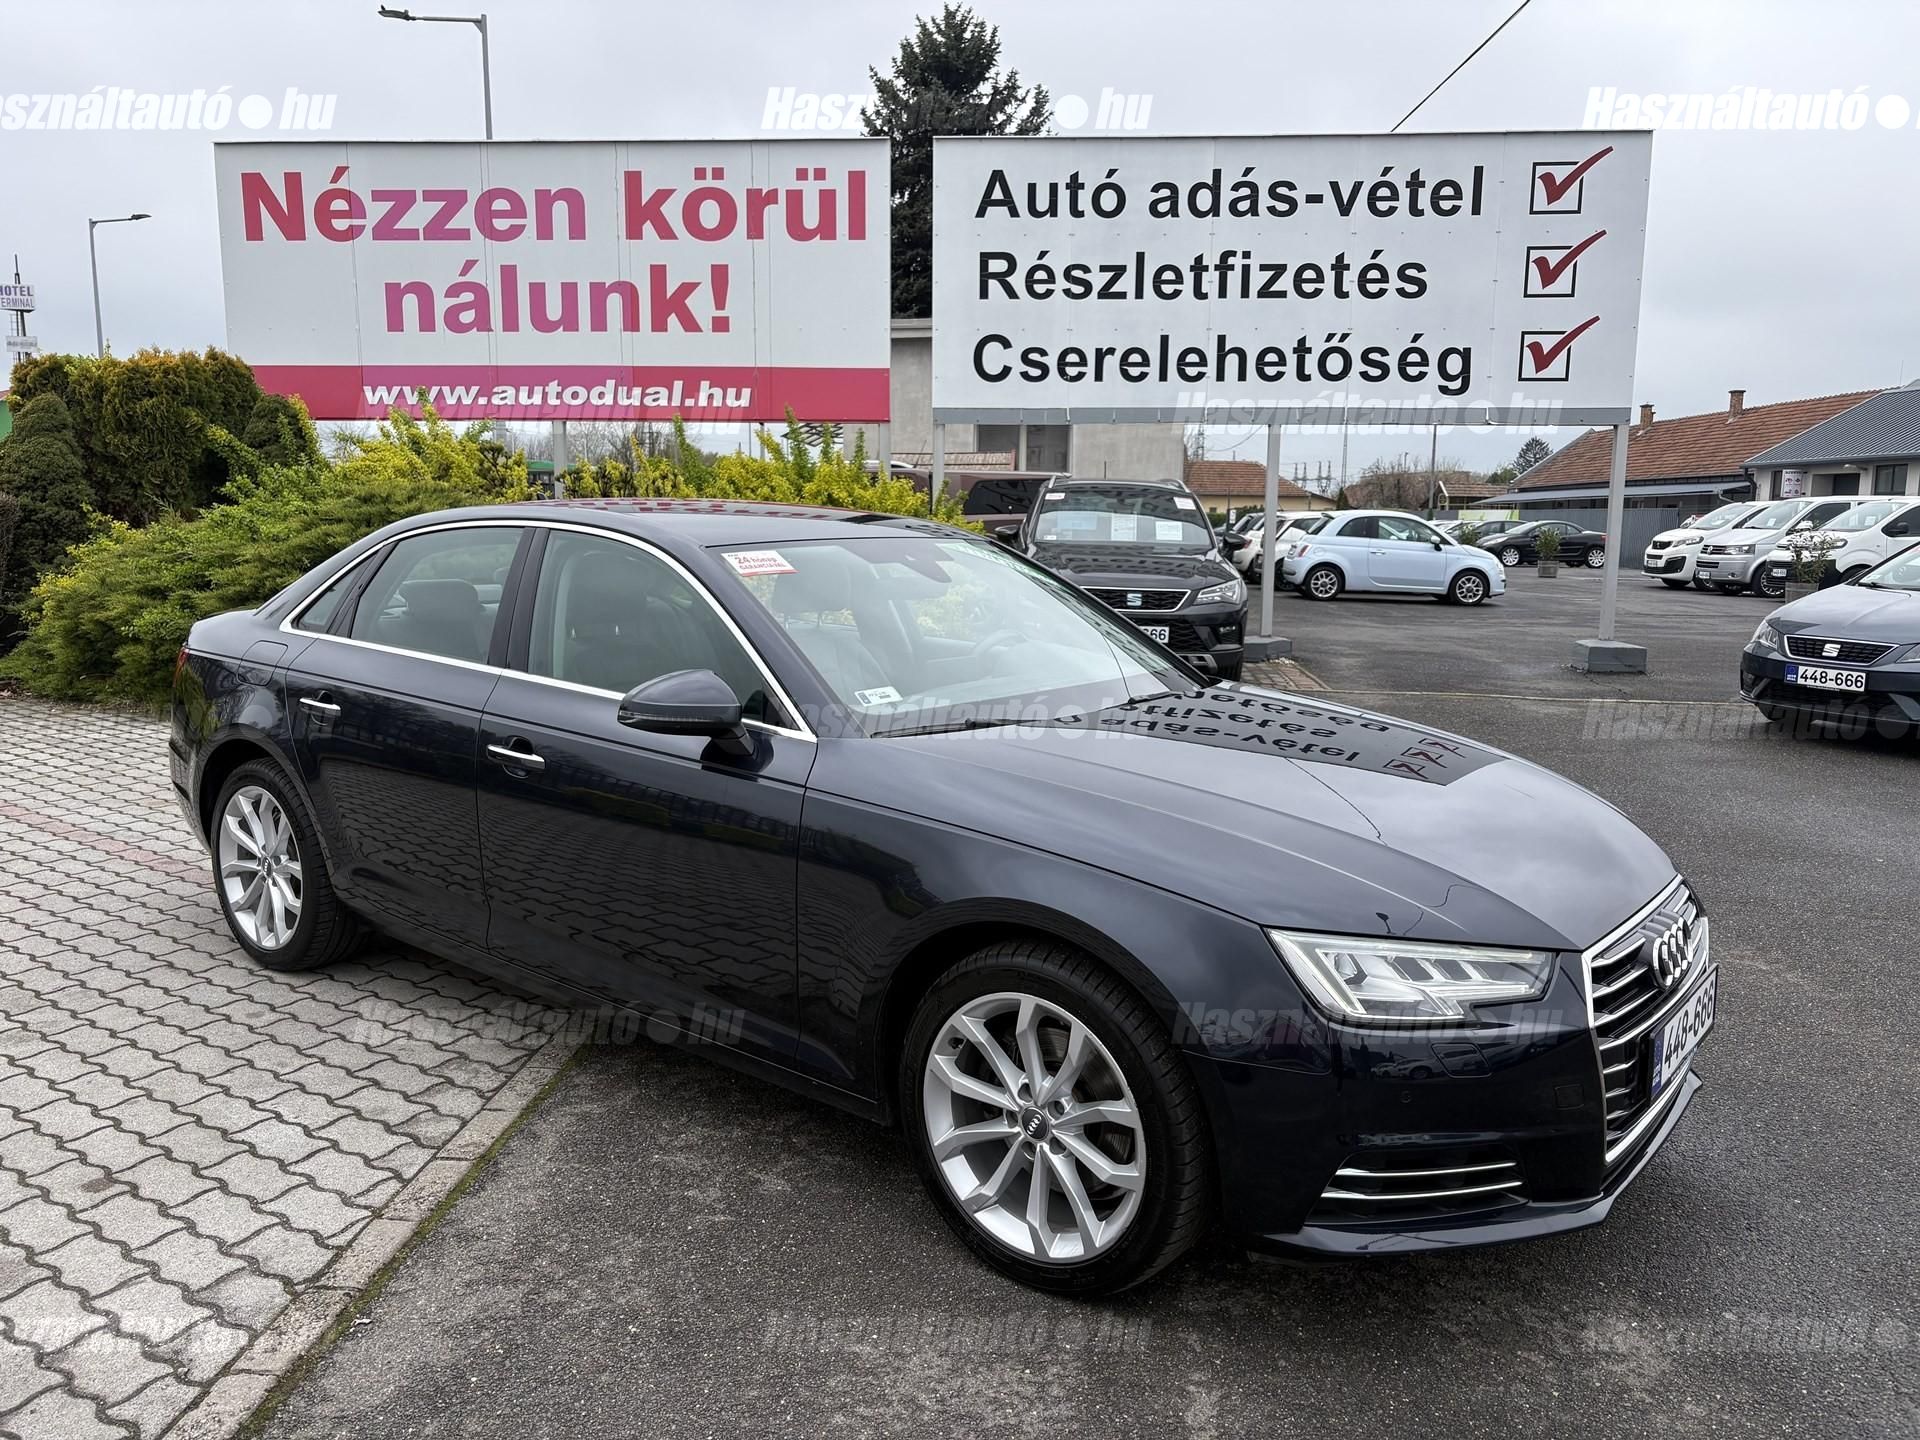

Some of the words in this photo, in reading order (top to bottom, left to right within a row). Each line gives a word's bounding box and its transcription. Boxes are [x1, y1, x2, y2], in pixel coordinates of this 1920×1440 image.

[241, 166, 587, 242] Nézzen
[624, 167, 867, 241] körül
[975, 168, 1127, 219] Autó
[1148, 165, 1485, 219] adás-vétel
[384, 259, 731, 334] nálunk!
[979, 249, 1428, 301] Részletfizetés
[0, 297, 35, 308] ERMINAL
[973, 332, 1473, 396] Cserelehetőség
[363, 379, 752, 409] www.autodual.hu
[1142, 628, 1167, 641] 66
[1800, 668, 1864, 689] 448-666
[1664, 979, 1714, 1069] 448-666
